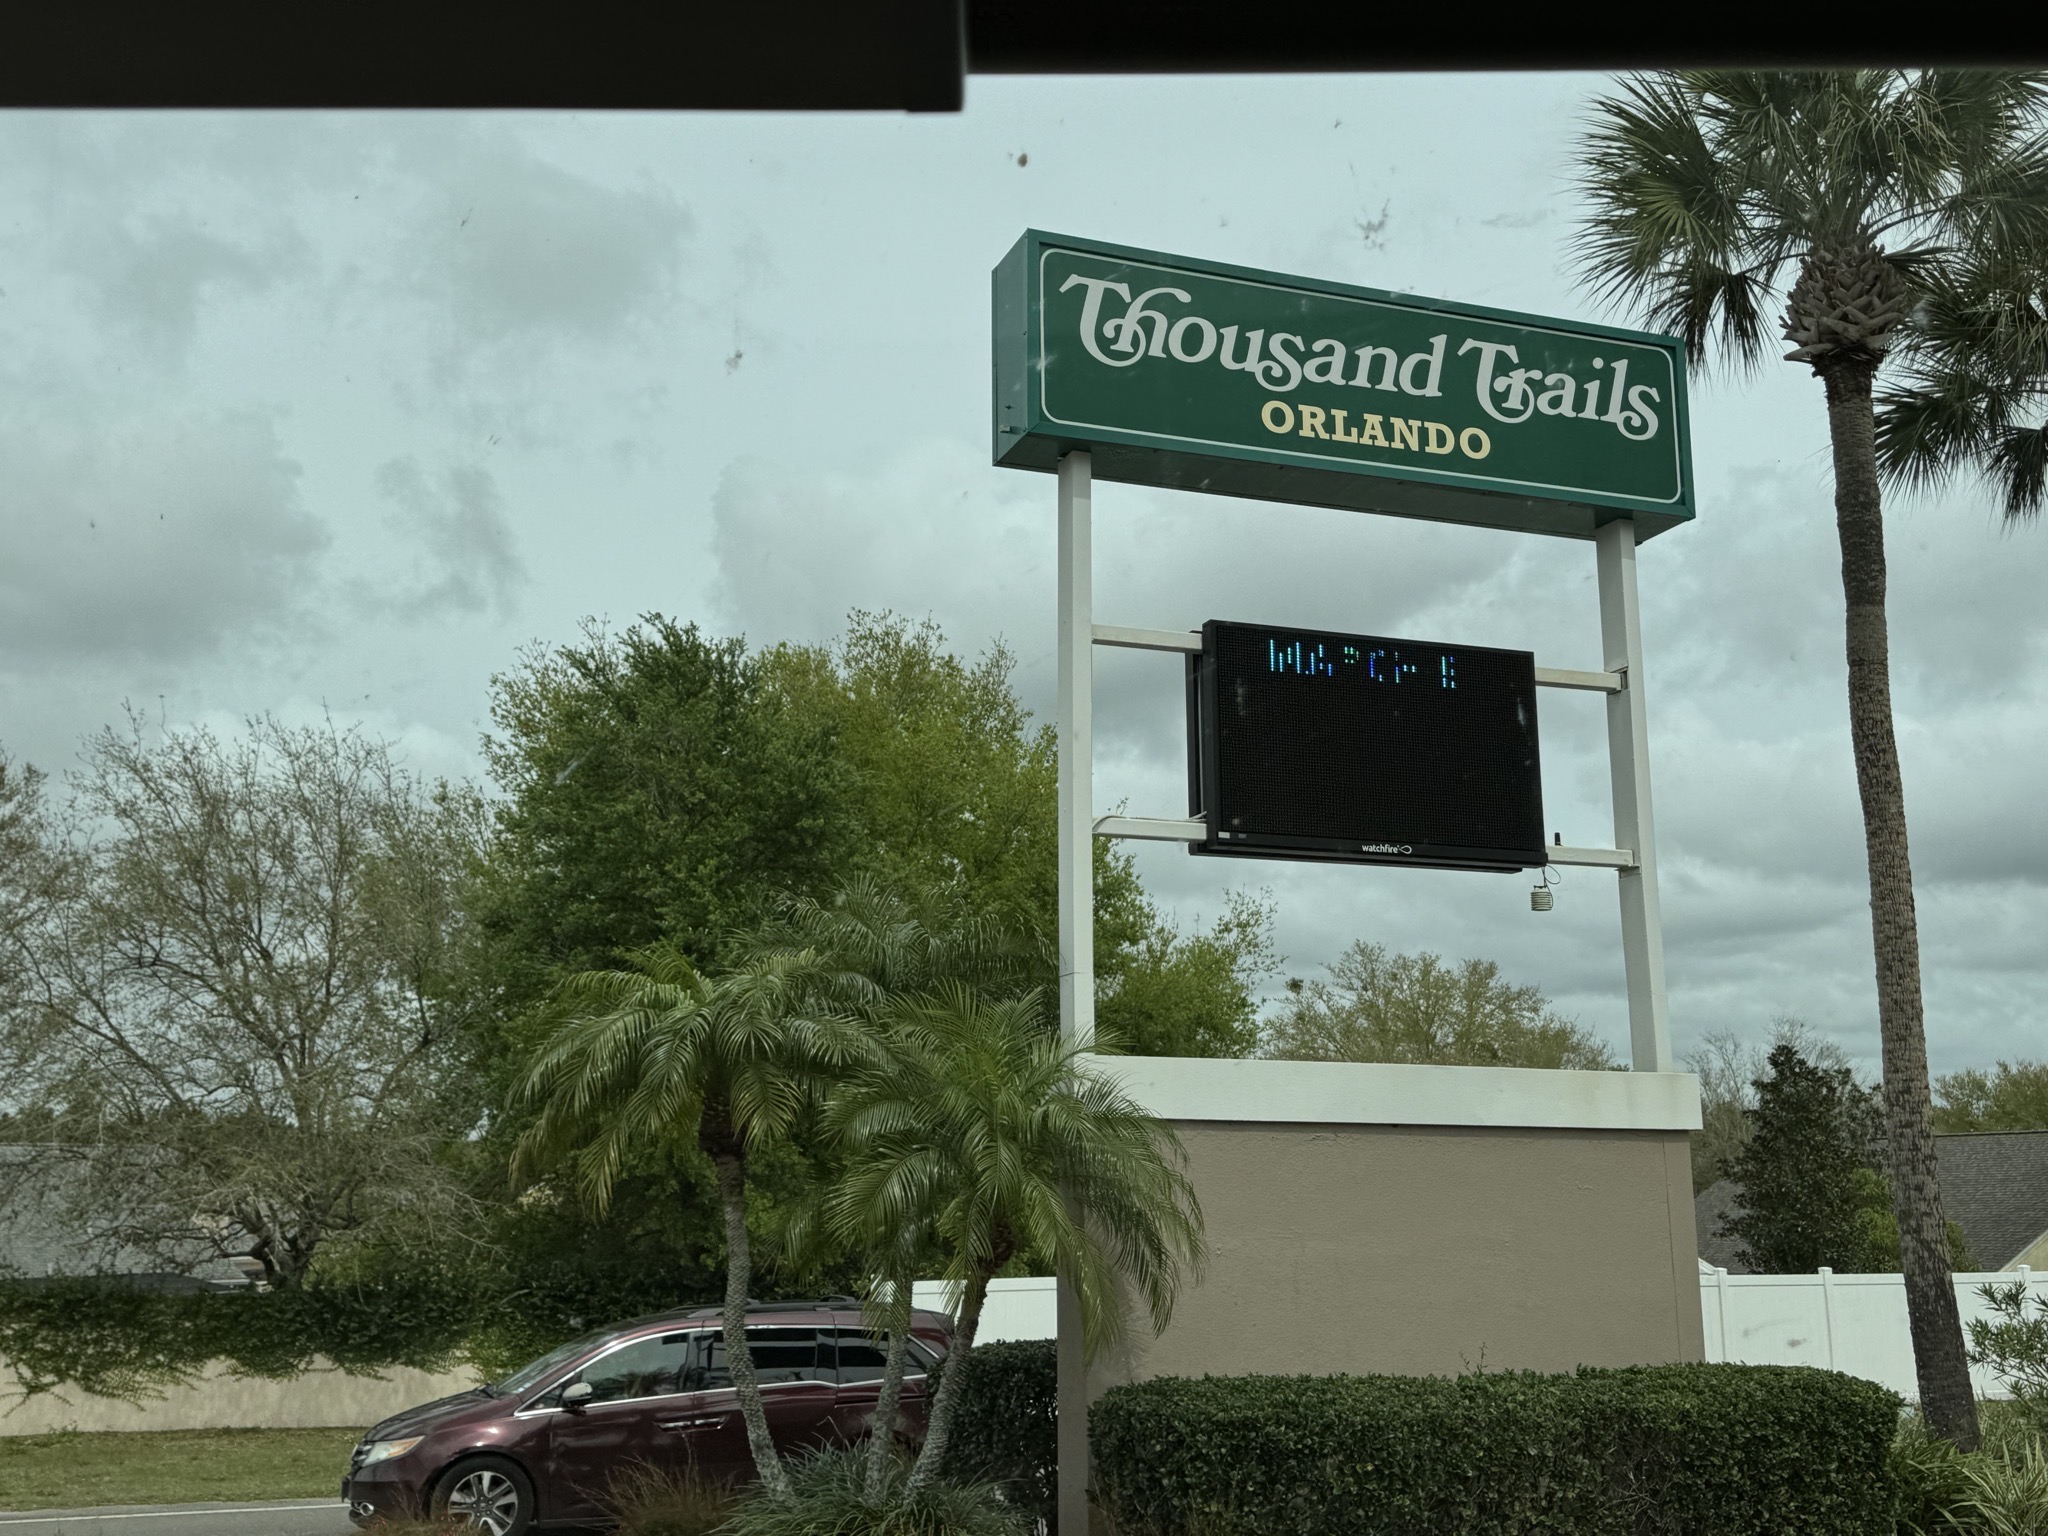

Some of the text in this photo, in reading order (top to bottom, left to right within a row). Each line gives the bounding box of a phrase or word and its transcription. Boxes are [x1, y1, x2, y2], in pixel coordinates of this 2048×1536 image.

[1059, 274, 1661, 440] Thousand Trails
[1262, 400, 1491, 459] ORLANDO
[1361, 843, 1399, 854] watchfire
